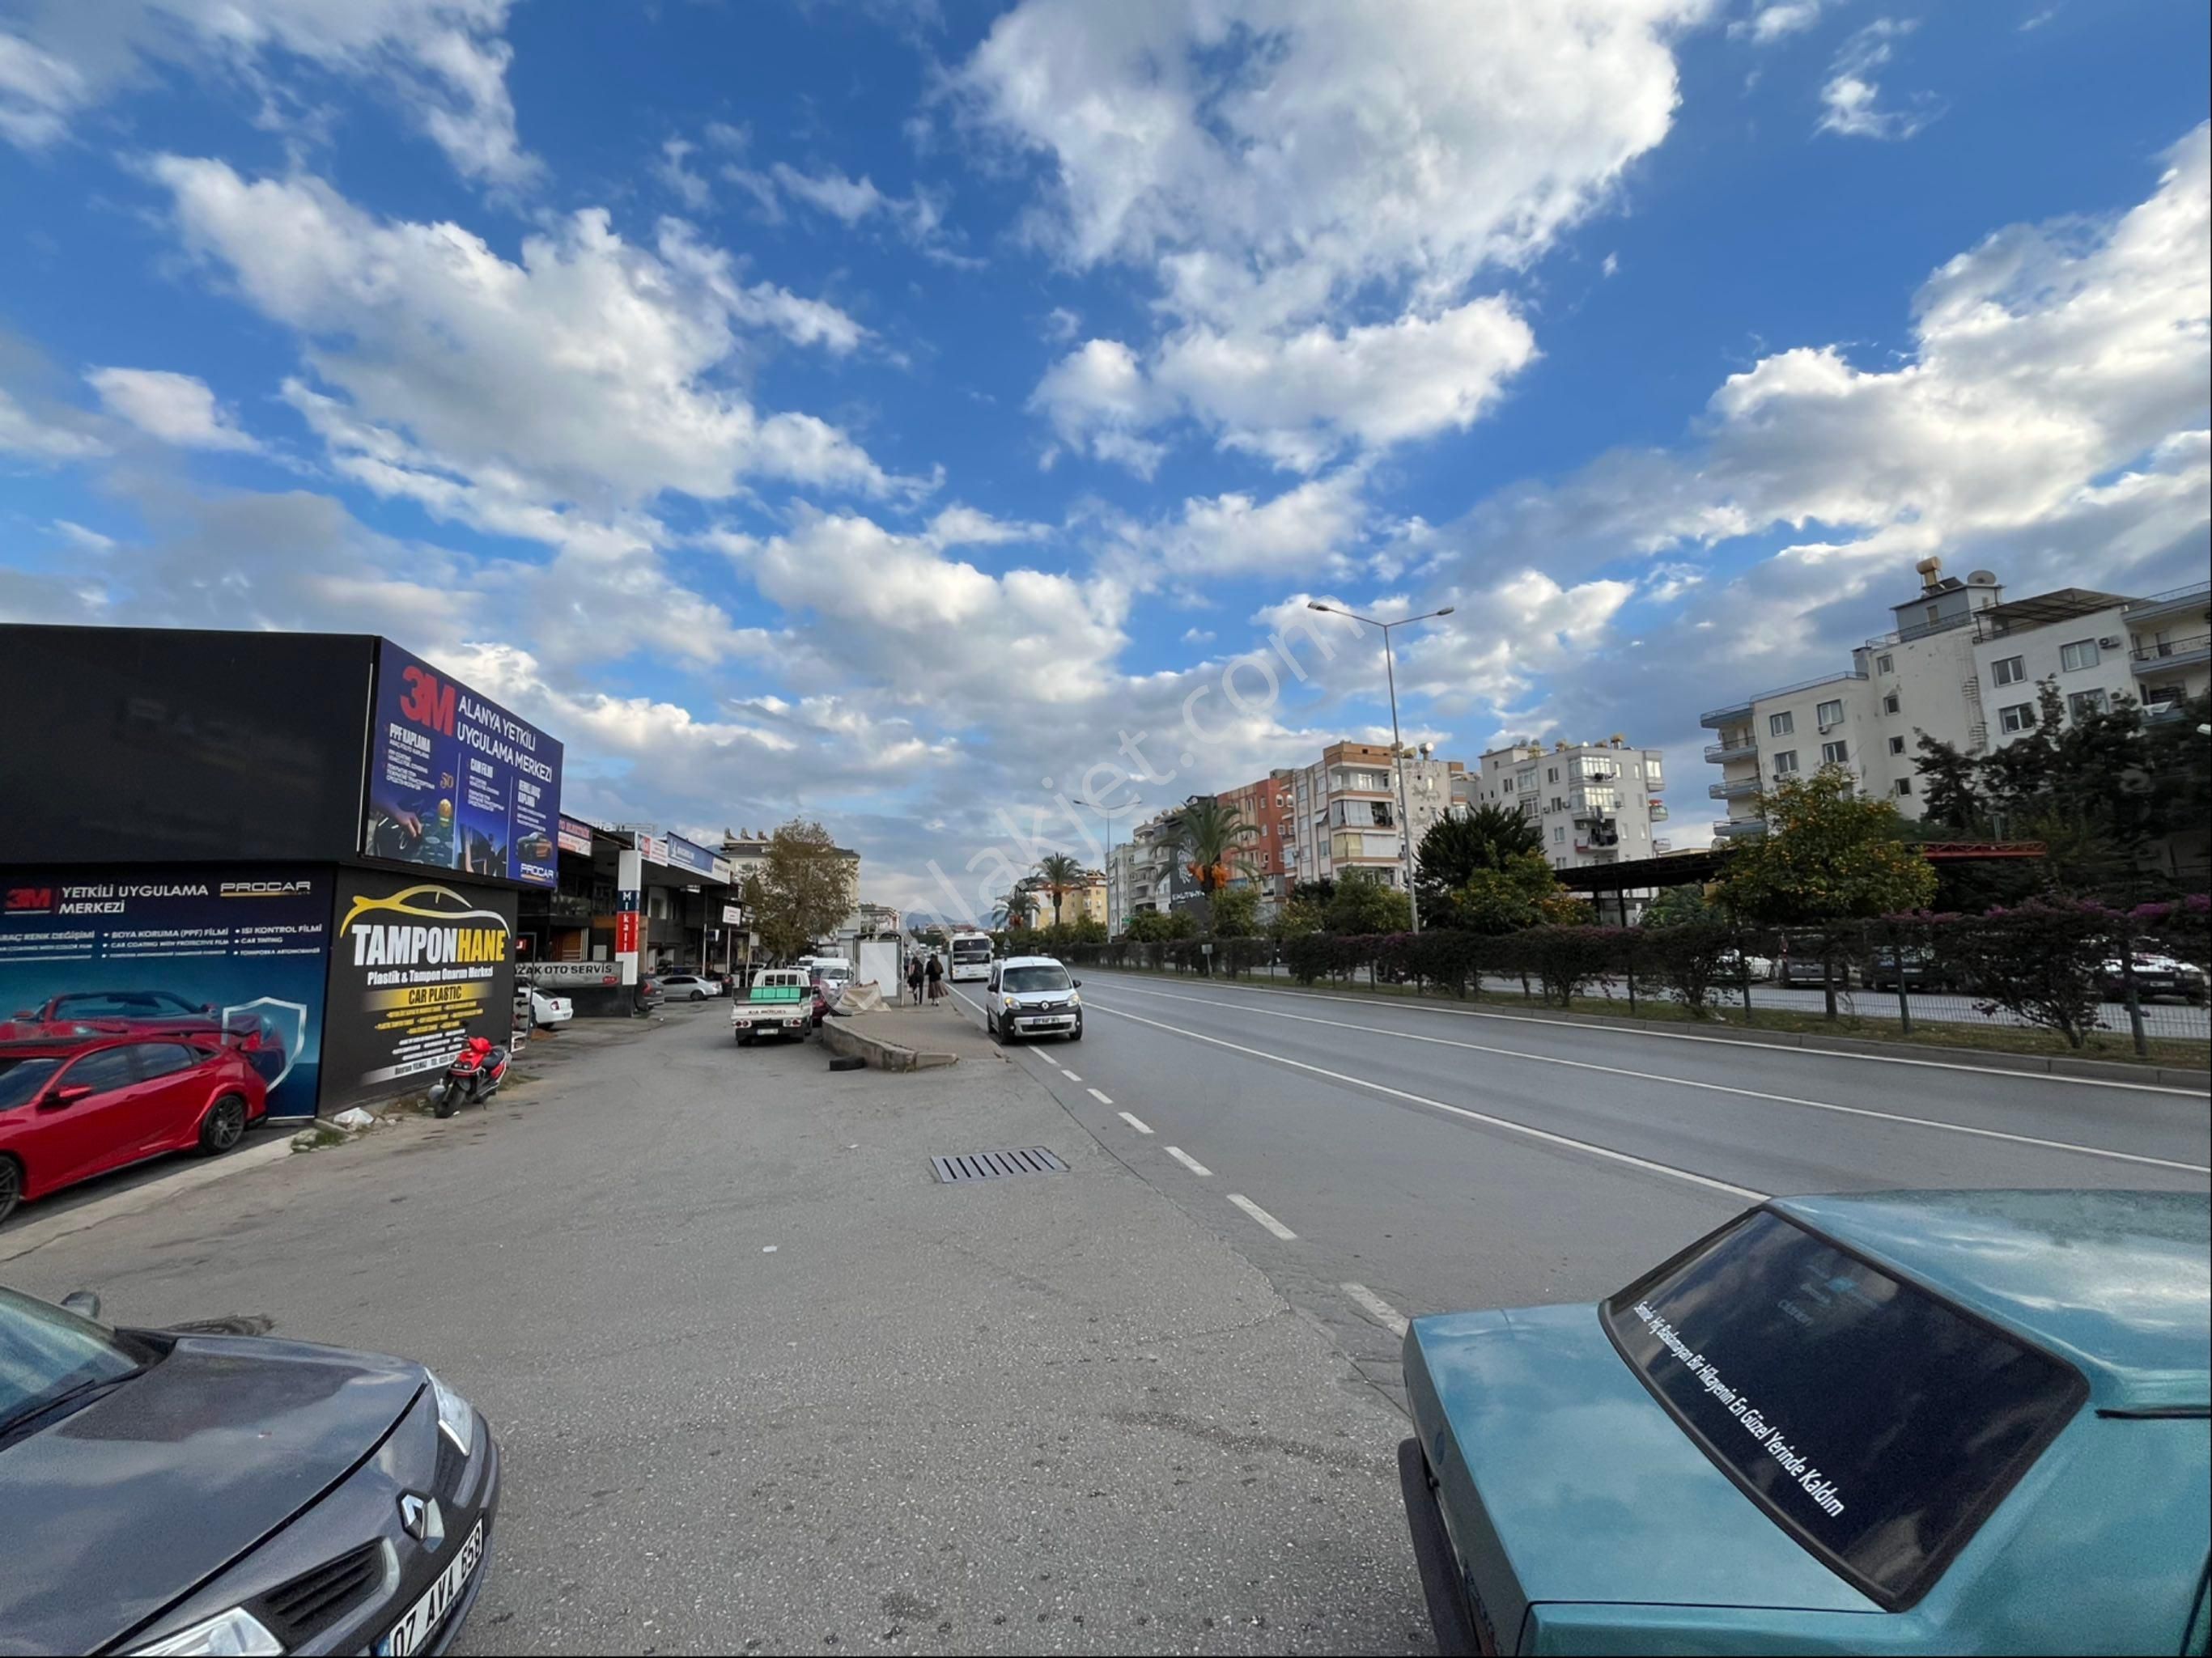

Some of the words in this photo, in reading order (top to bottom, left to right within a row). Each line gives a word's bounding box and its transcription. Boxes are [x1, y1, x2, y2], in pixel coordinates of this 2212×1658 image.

[400, 665, 456, 736] 3M
[459, 695, 501, 733] ALANYA
[503, 718, 536, 752] YETKİLİ
[457, 722, 514, 765] UYGULAMA
[515, 753, 552, 783] MERKEZİ
[520, 863, 554, 880] PROCAR
[5, 888, 51, 909] 3M
[62, 884, 113, 898] YETKİLİ
[119, 884, 209, 897] UYGULAMA
[220, 881, 311, 892] PROCAR
[59, 900, 125, 914] MERKEZİ
[204, 927, 228, 936] FİLMİ
[255, 926, 297, 934] KONTROL
[299, 923, 322, 932] FİLMİ
[351, 924, 506, 966] TAMPONHANE
[367, 971, 401, 986] Plastik
[401, 972, 408, 983] &
[410, 969, 441, 982] Tampon
[545, 965, 568, 974] OTO
[571, 963, 612, 974] SERVİS
[409, 989, 427, 1004] CAR
[429, 986, 462, 1001] PLASTIC
[1686, 1354, 1705, 1371] Bir
[1728, 1397, 1748, 1416] En
[1740, 1409, 1777, 1440] Güzel
[1764, 1431, 1808, 1477] Yerinde
[1798, 1469, 1845, 1517] Kaldım
[393, 1609, 417, 1656] 07
